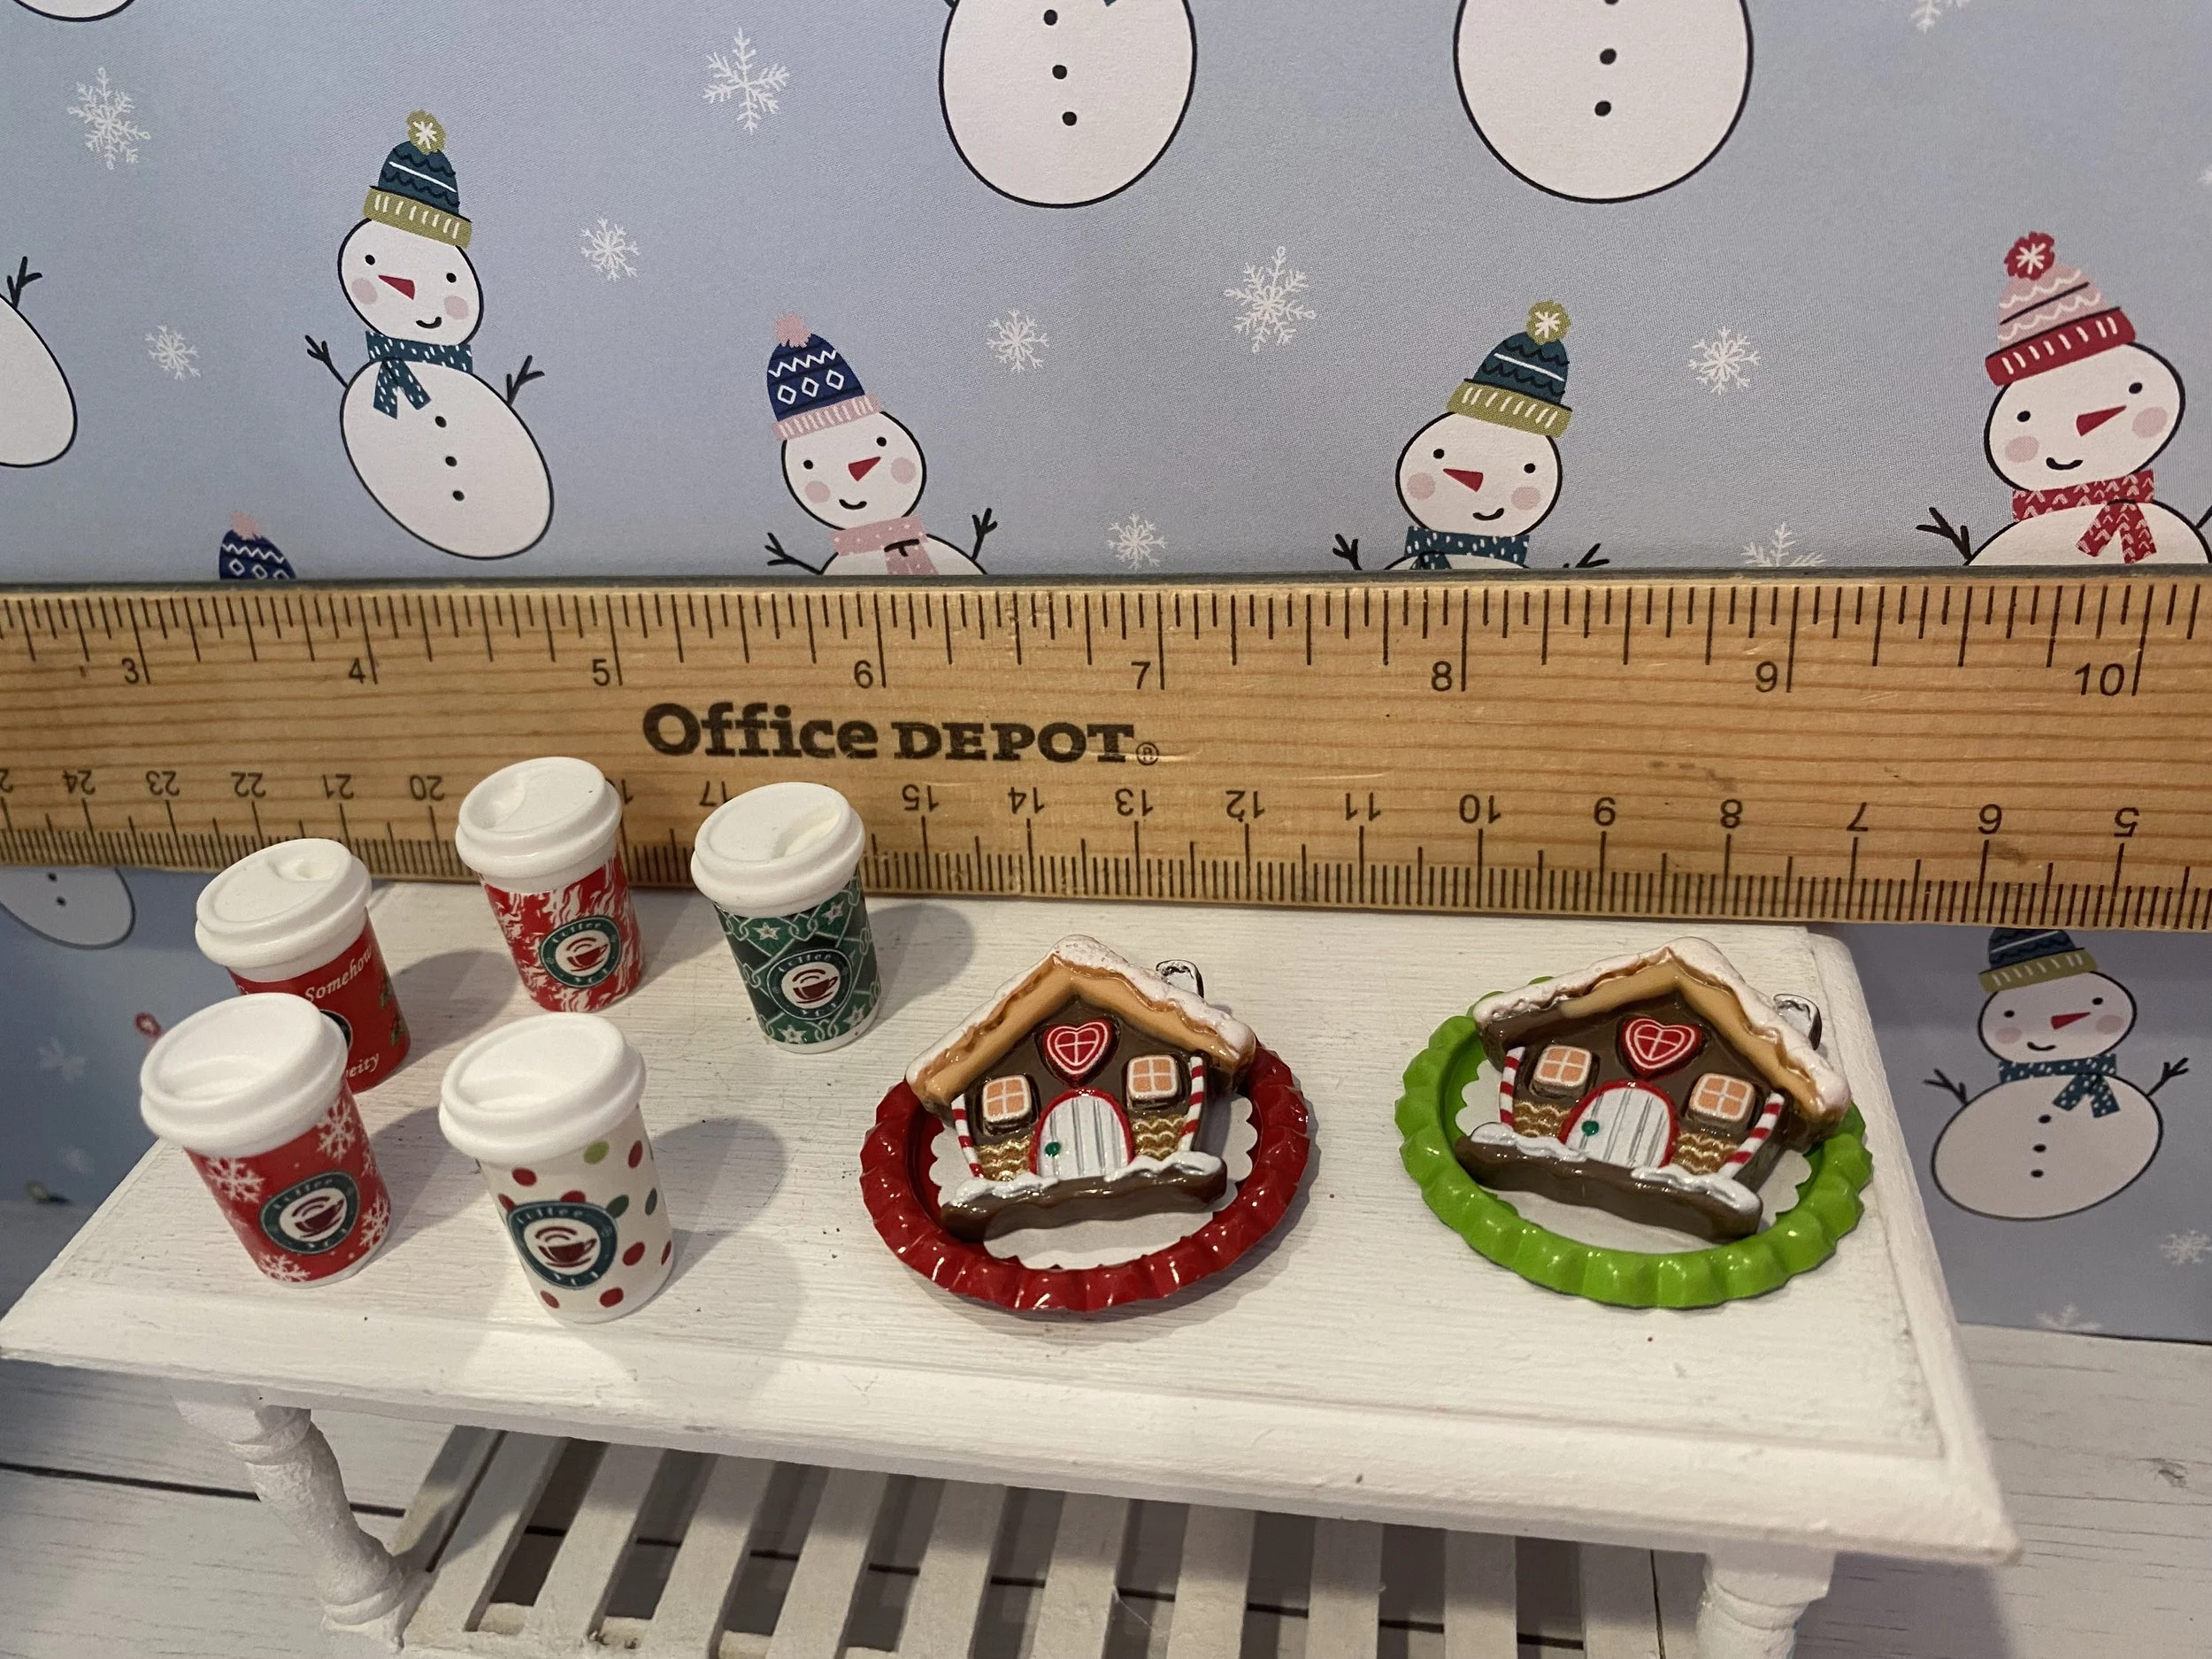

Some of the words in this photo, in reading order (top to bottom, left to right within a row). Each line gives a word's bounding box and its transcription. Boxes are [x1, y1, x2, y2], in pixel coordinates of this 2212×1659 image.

[123, 657, 140, 685] 3
[348, 657, 365, 684] 4
[593, 659, 611, 687] 5
[854, 660, 873, 688] 6
[1132, 662, 1150, 689] 7
[1432, 661, 1452, 692] 8
[1755, 661, 1778, 693] 9
[2075, 663, 2124, 696] 10
[642, 702, 878, 759] Office
[62, 769, 96, 795] 24
[146, 771, 180, 796] 23
[231, 772, 266, 798] 22
[322, 774, 354, 800] 21
[410, 774, 445, 802] 20
[902, 784, 939, 812] 15
[1008, 787, 1044, 814] 14
[1115, 788, 1153, 816] 13
[1225, 790, 1264, 819] 12
[1346, 792, 1381, 821] 11
[1459, 795, 1501, 824] 10
[1720, 799, 1742, 829] 8
[1847, 803, 1869, 832] 7
[2114, 808, 2139, 837] 5
[304, 946, 372, 1002] Somehow
